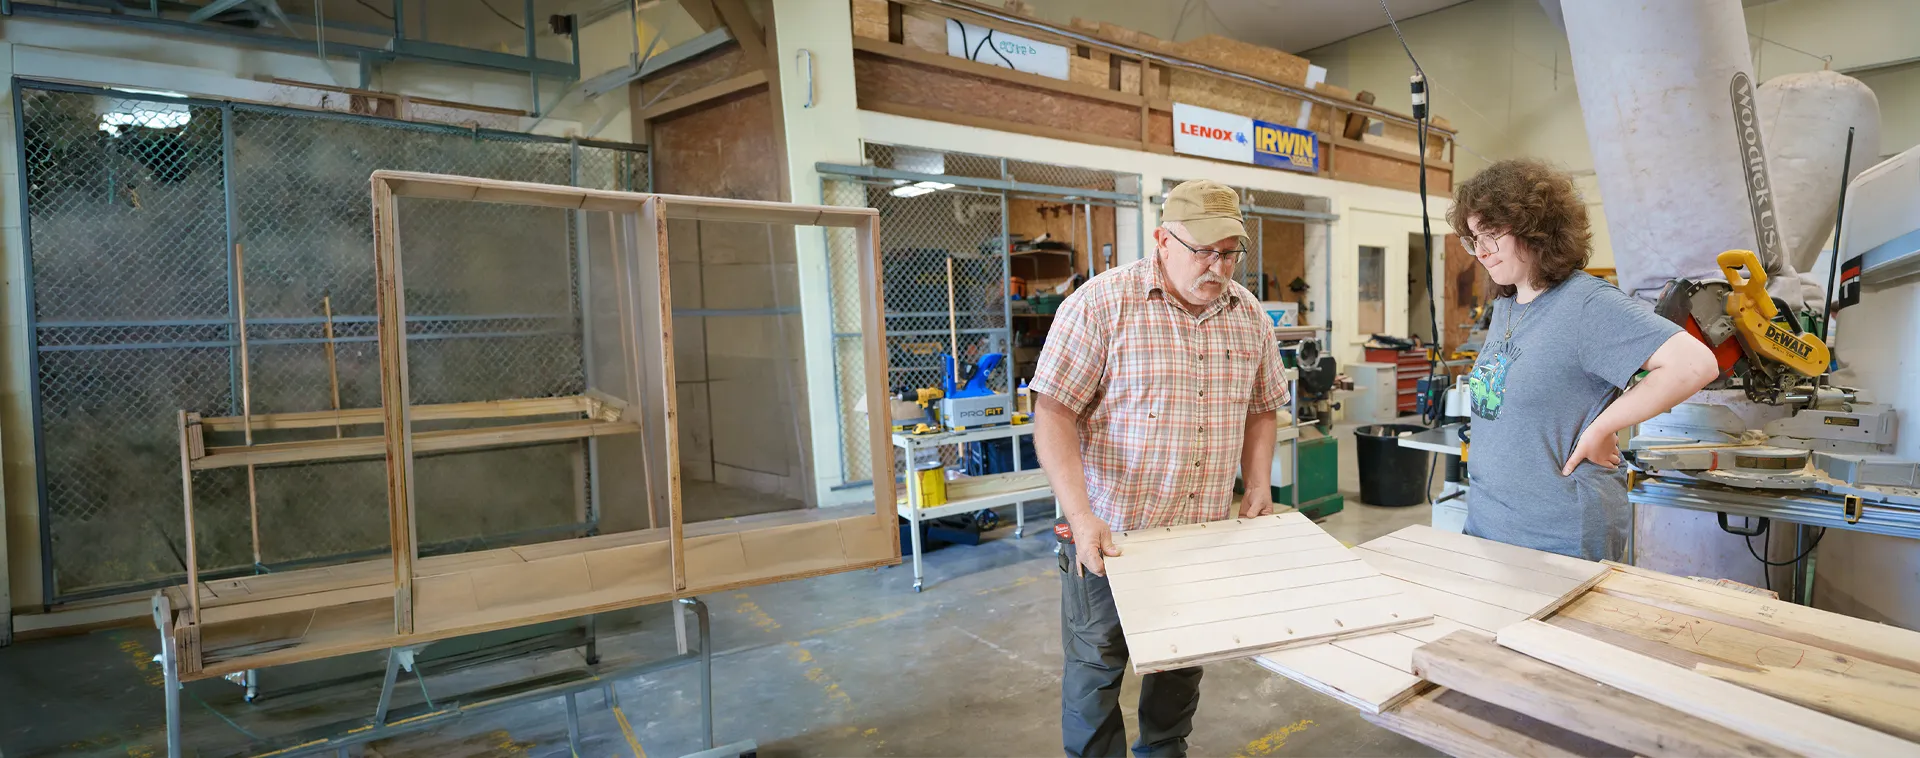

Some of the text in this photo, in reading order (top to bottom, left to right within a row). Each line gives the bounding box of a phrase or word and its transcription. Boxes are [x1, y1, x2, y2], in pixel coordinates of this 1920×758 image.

[1180, 122, 1232, 142] LENOX
[1255, 126, 1313, 158] IRWIN
[1737, 82, 1779, 269] Woodtek USA
